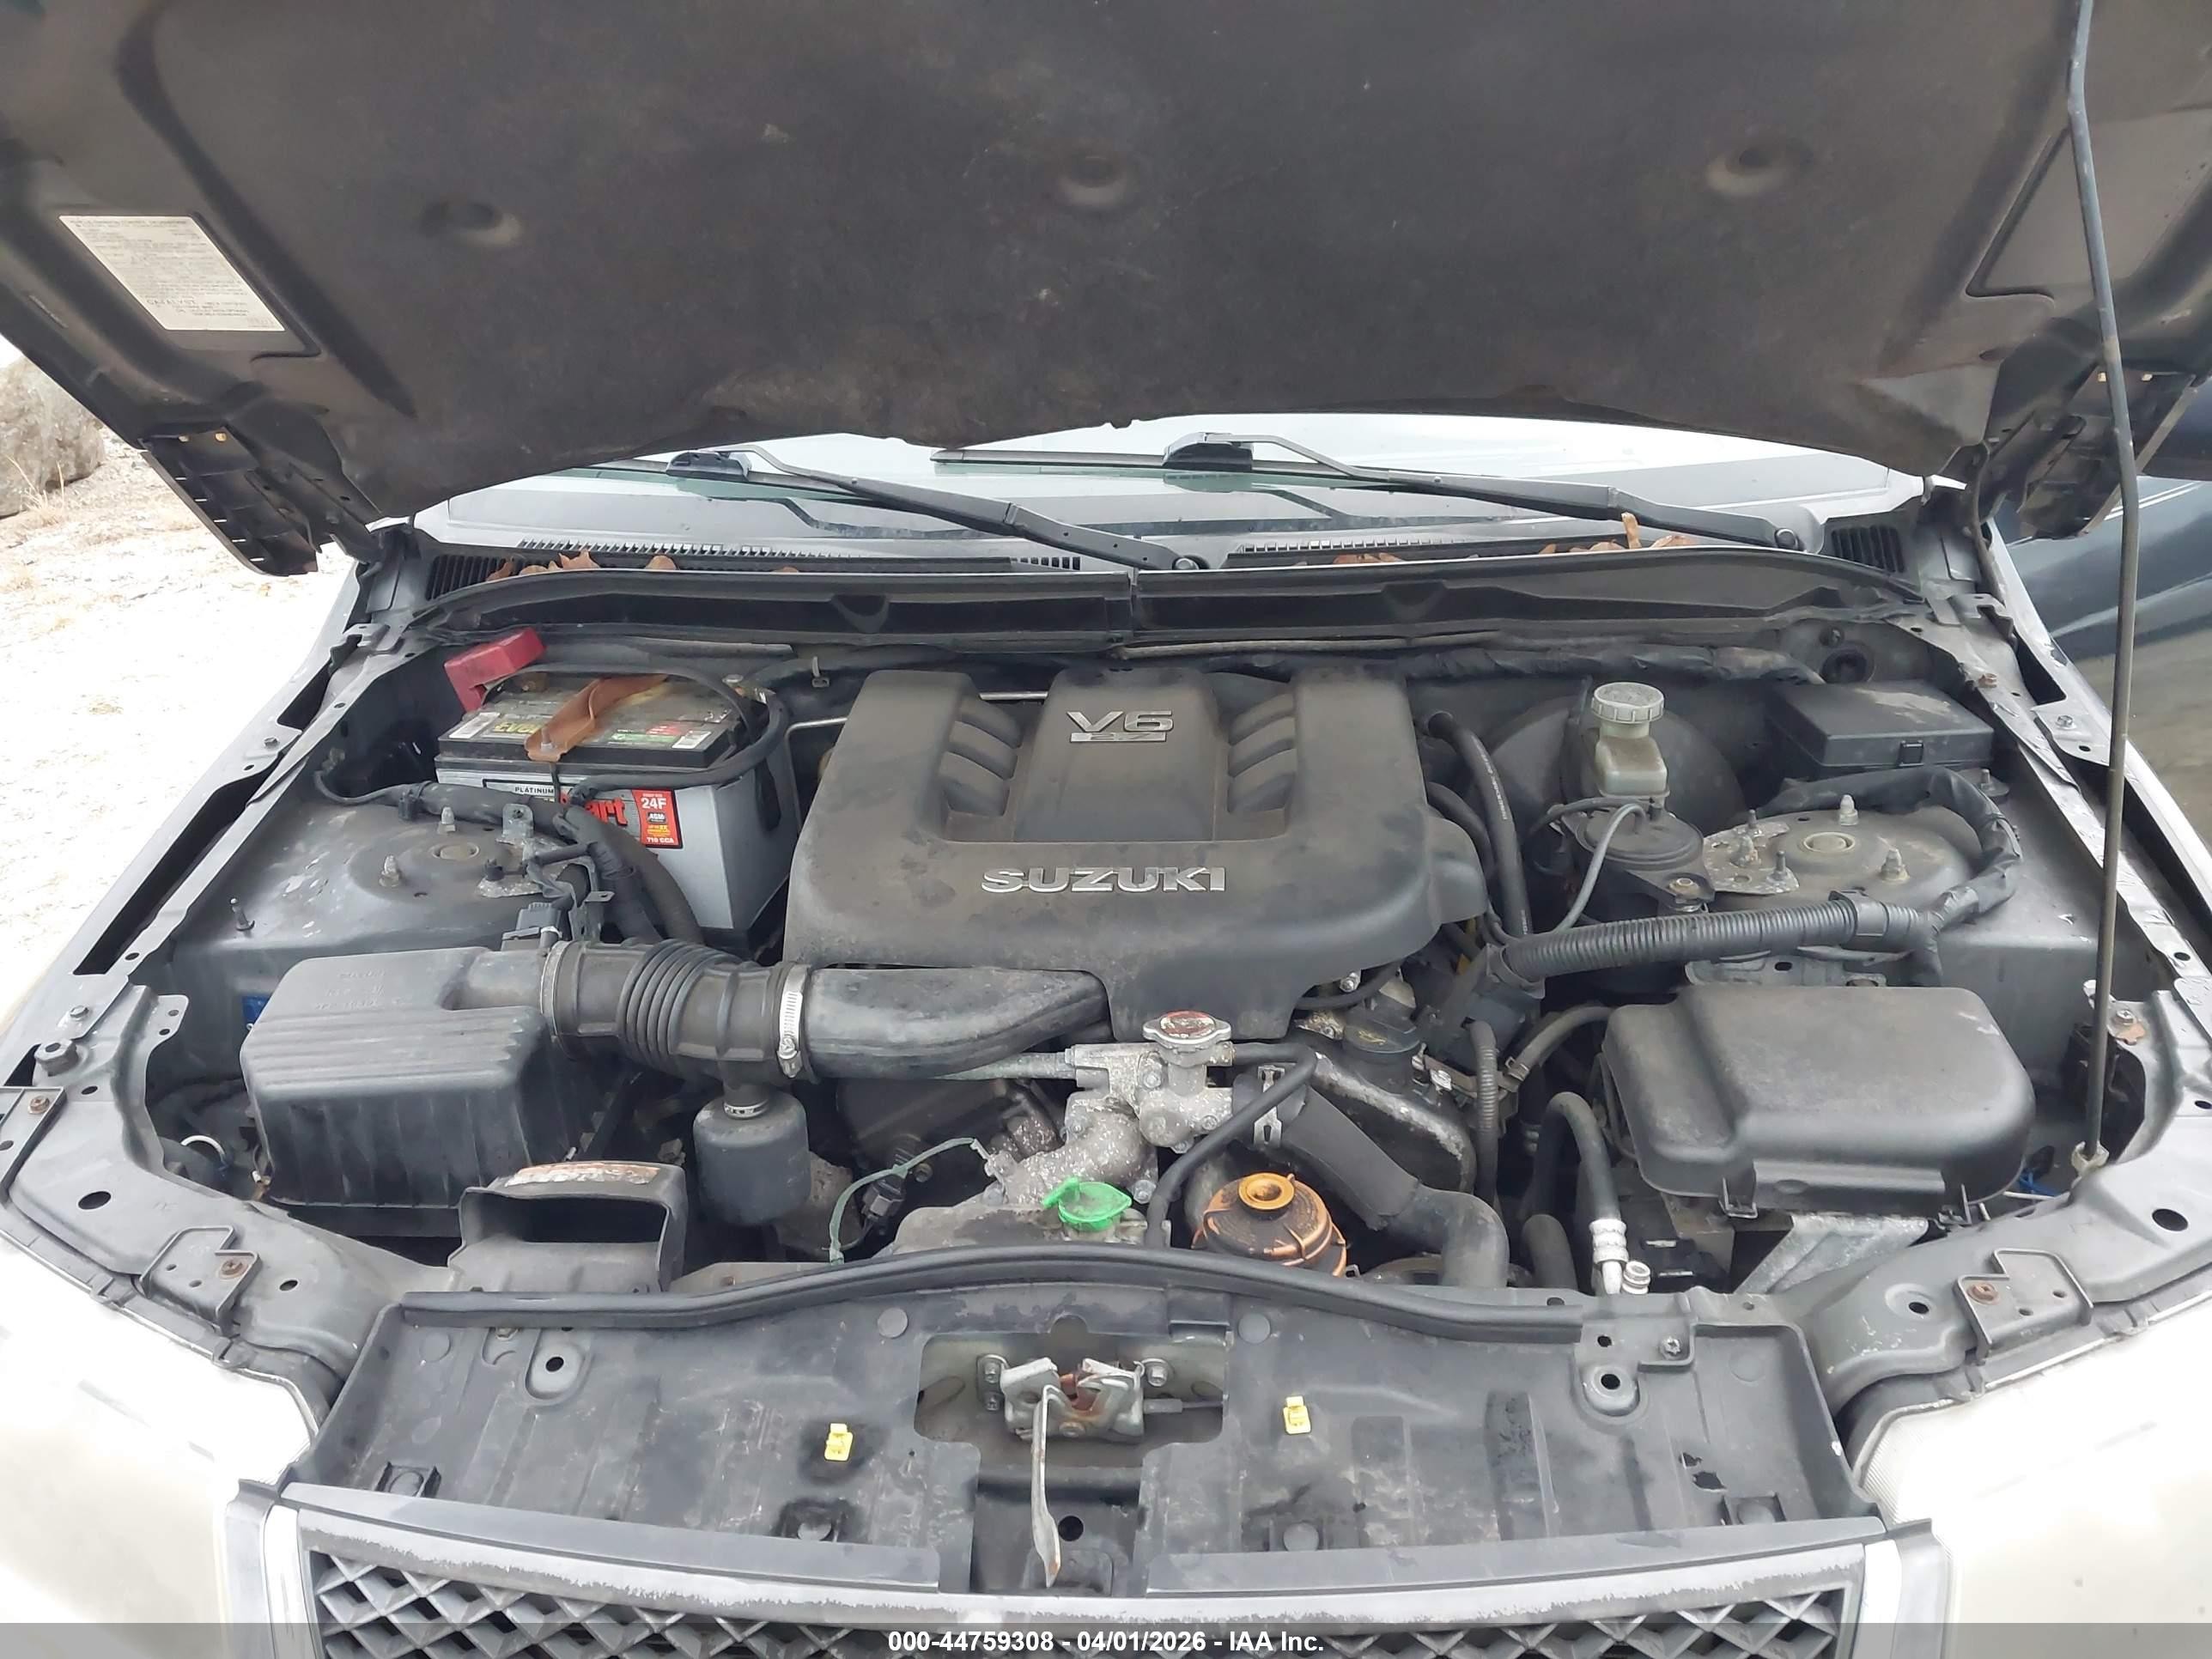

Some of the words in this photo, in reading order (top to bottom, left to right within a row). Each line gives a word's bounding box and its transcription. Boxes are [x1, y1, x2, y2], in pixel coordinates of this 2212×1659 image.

[1066, 710, 1174, 732] V6
[514, 786, 555, 794] PLATINUM
[640, 797, 667, 810] 24F
[981, 866, 1227, 893] SUZUKI
